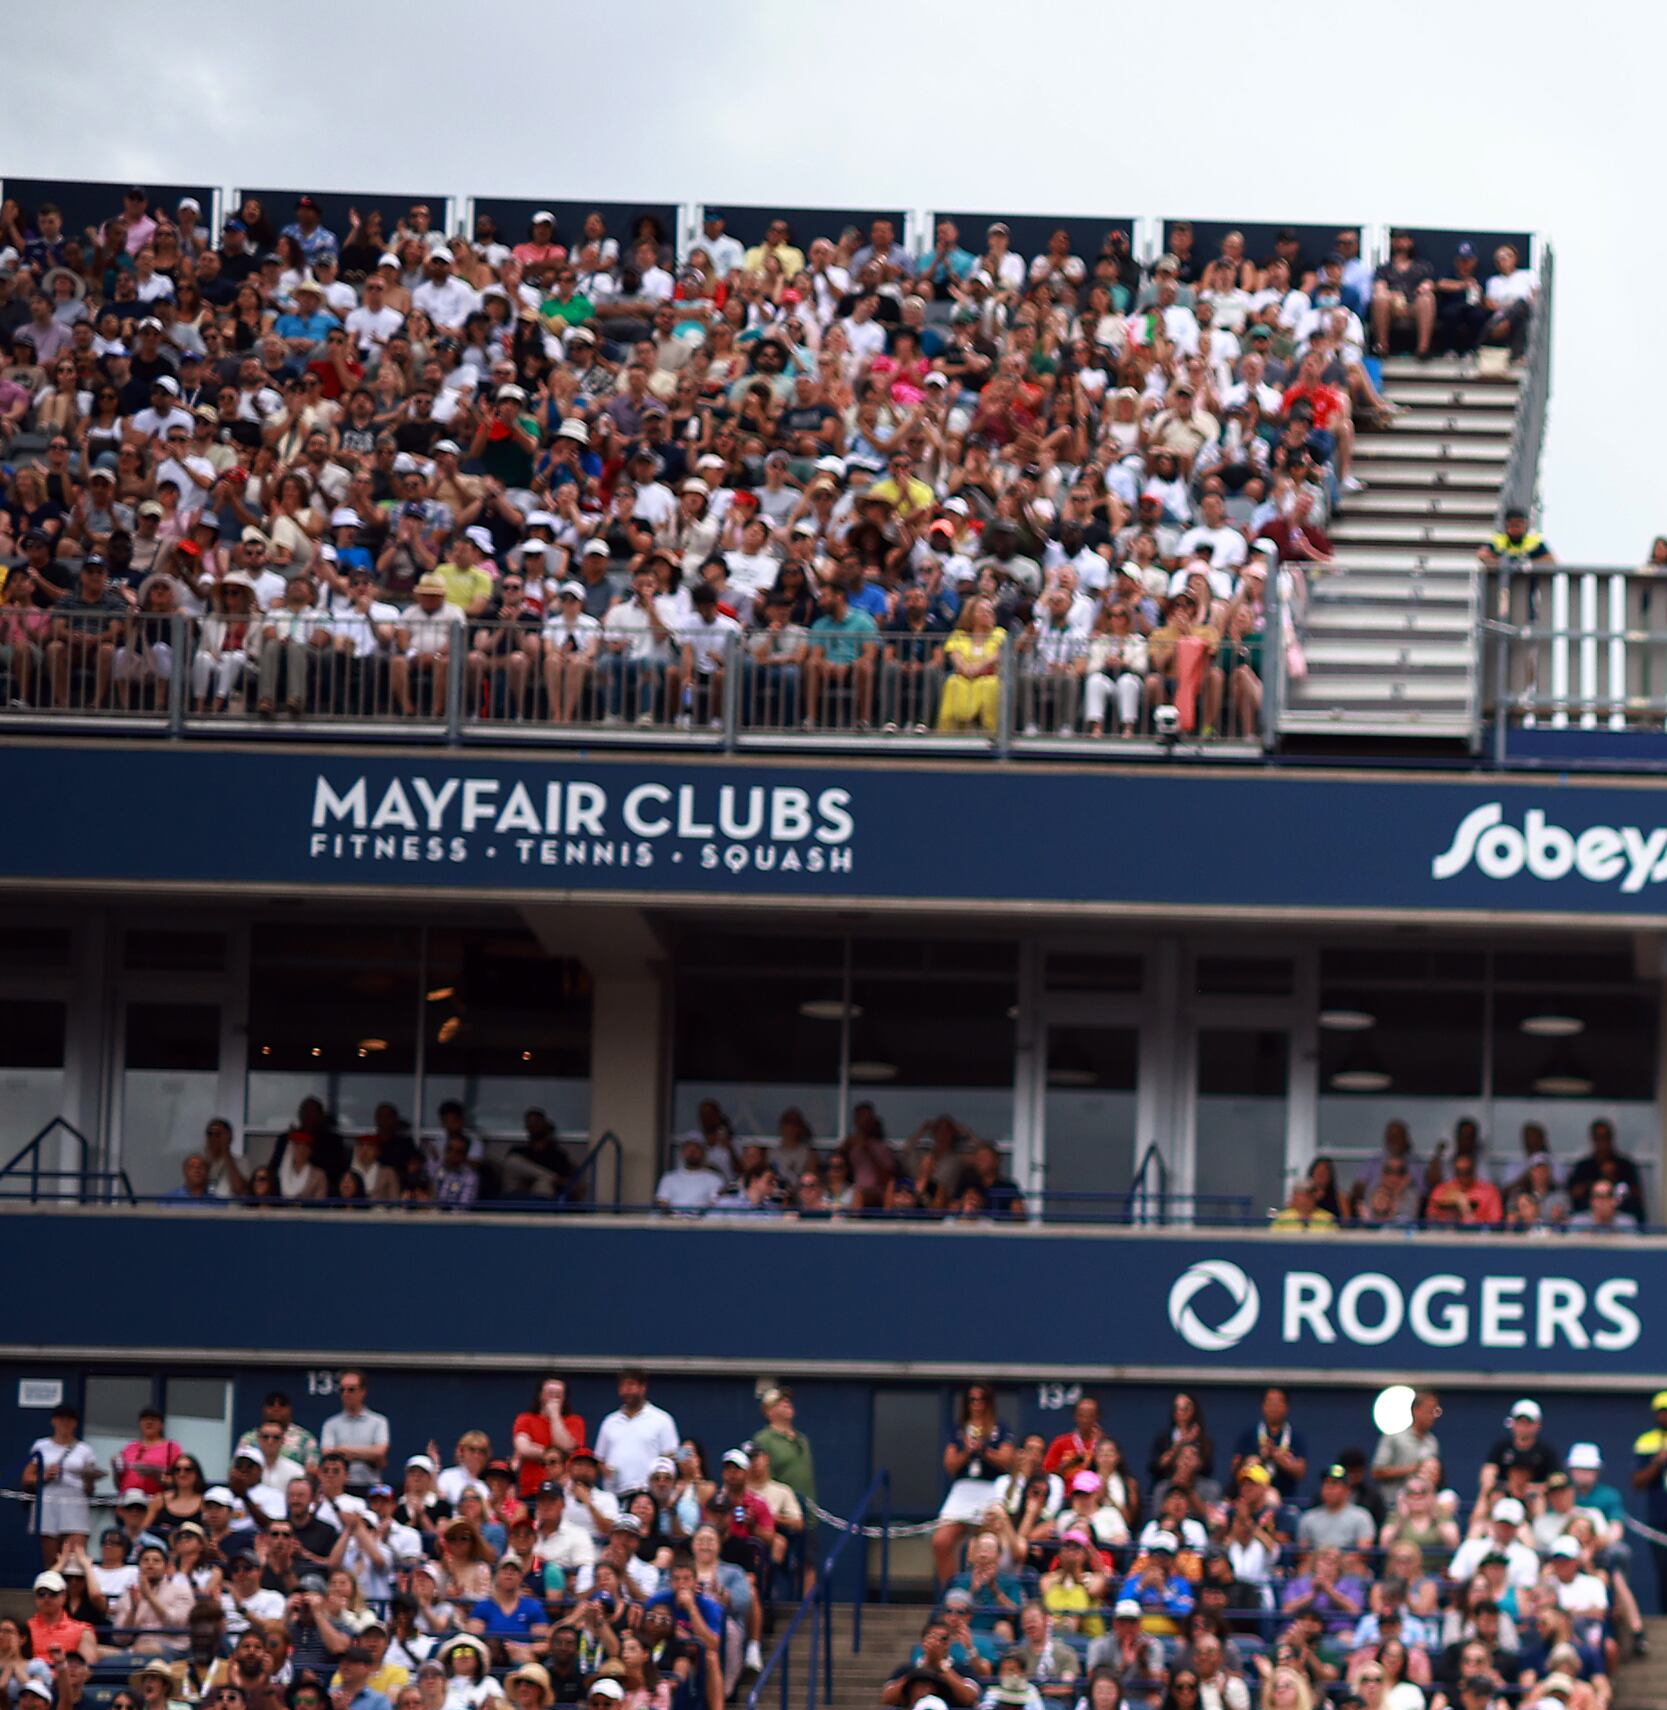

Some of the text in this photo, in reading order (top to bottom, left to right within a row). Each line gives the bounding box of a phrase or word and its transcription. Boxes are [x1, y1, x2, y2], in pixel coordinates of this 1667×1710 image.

[312, 776, 853, 845] MAYFAIR CLUBS
[310, 832, 855, 875] FITNESS TENNIS SQUASH
[1283, 1272, 1640, 1350] ROGERS
